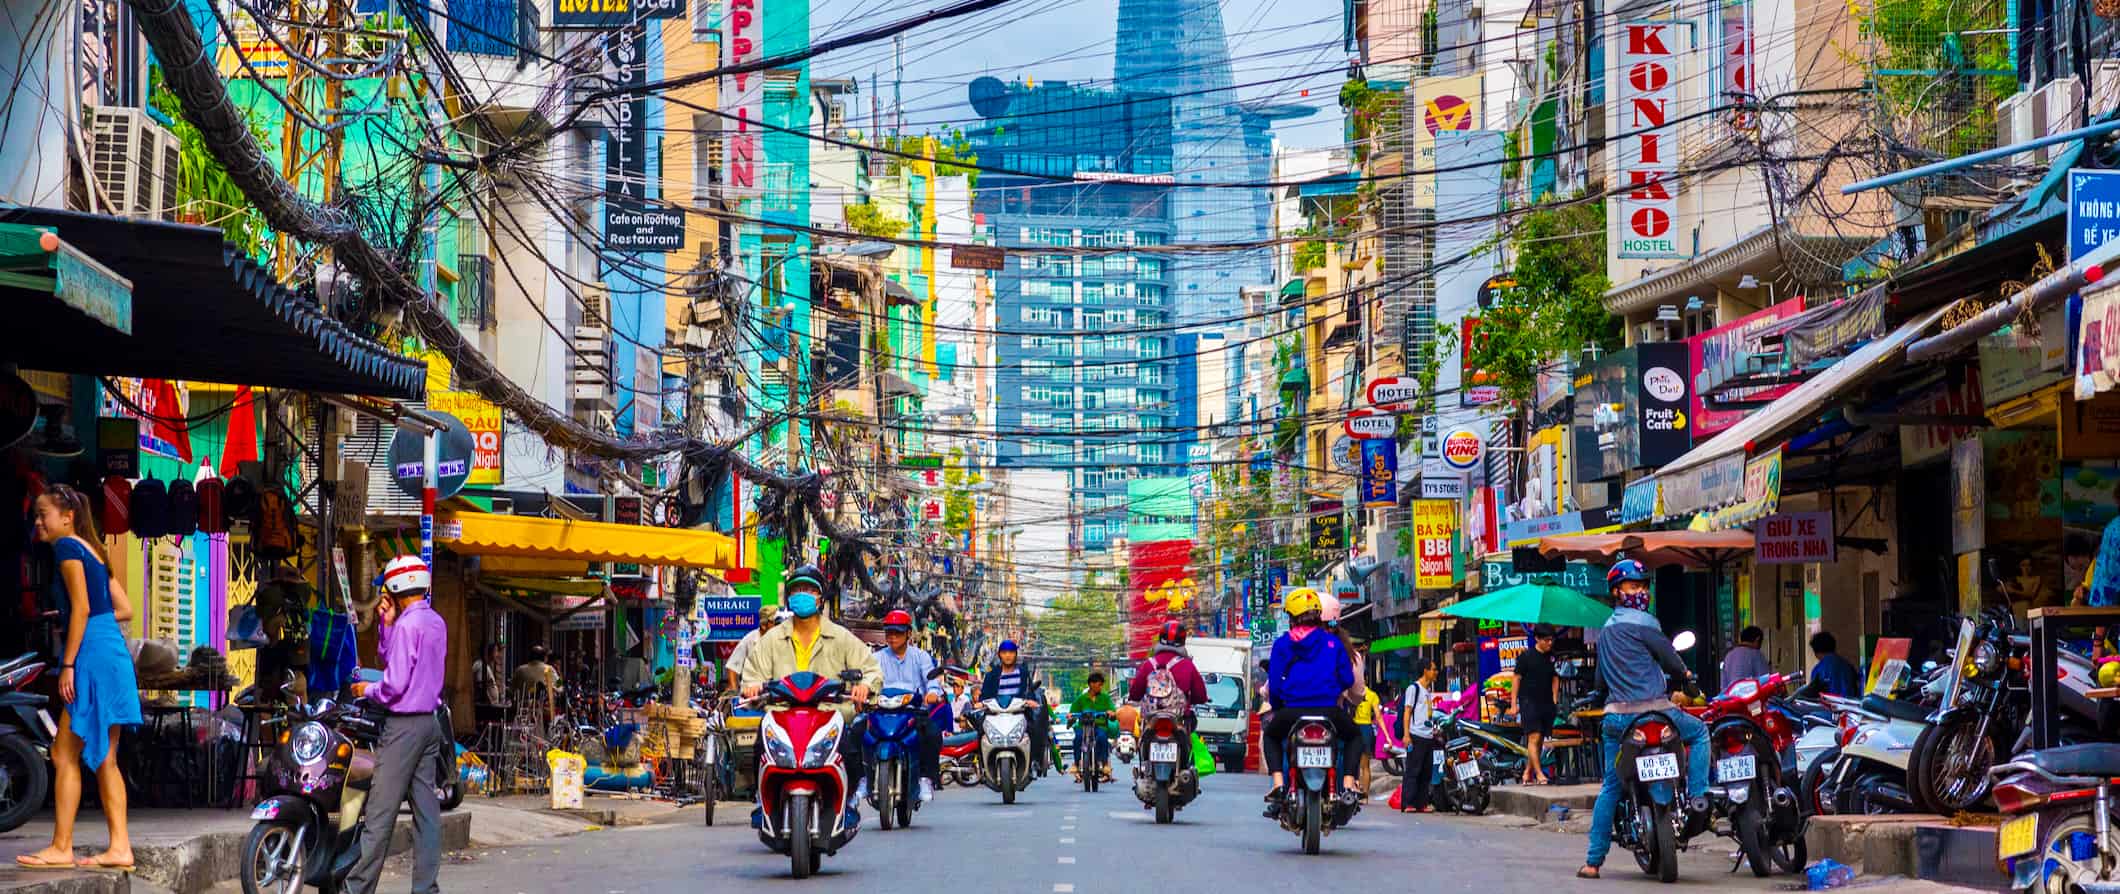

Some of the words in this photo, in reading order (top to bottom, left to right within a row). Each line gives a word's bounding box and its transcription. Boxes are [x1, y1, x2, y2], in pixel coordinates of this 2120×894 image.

[1626, 25, 1670, 238] KONIKO
[731, 107, 753, 187] INN
[2079, 199, 2113, 219] KHÔNG
[609, 214, 630, 225] Cafe
[636, 225, 654, 234] and
[610, 233, 679, 245] Restaurant
[1624, 240, 1675, 252] HOSTEL
[1377, 387, 1416, 400] HOTEL
[1646, 408, 1673, 420] Fruit
[1354, 418, 1391, 429] HOTEL
[1646, 419, 1673, 431] Cafe
[1446, 437, 1479, 449] BURGER
[1446, 447, 1479, 457] KING
[474, 450, 500, 470] Night
[1371, 452, 1393, 498] Tiger
[1316, 514, 1338, 526] Gym
[1797, 519, 1817, 536] XE
[1317, 535, 1336, 547] Spa
[1425, 539, 1452, 557] BB
[1760, 541, 1799, 559] TRONG
[1420, 558, 1444, 576] Saigon
[707, 600, 750, 609] MERAKI
